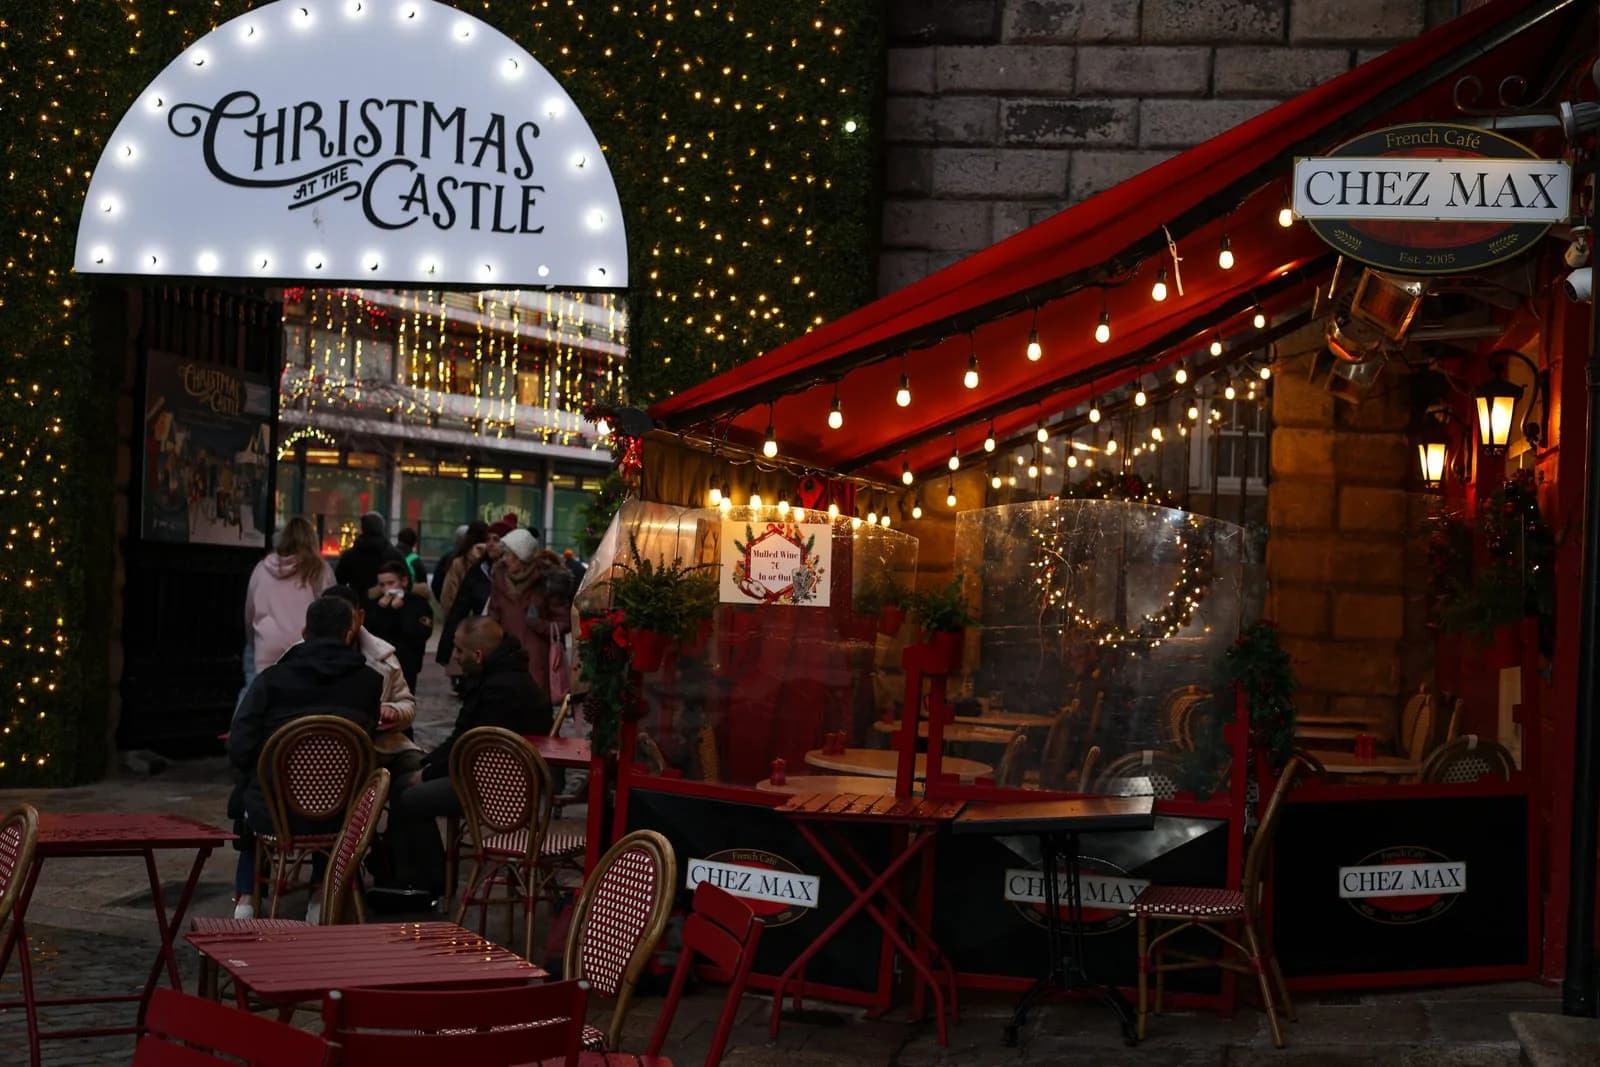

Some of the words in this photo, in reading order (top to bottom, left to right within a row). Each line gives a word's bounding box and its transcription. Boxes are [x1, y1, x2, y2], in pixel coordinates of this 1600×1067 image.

[168, 91, 540, 188] CHRISTMAS
[1385, 128, 1440, 148] French
[1444, 129, 1480, 149] Café
[293, 179, 317, 199] AT
[321, 166, 349, 189] THE
[362, 158, 546, 234] CASTLE
[1304, 170, 1431, 206] CHEZ
[1445, 171, 1559, 209] MAX
[1425, 253, 1456, 265] 2005
[753, 550, 778, 558] Mulled
[780, 550, 799, 559] Wine
[758, 572, 767, 580] In
[691, 865, 751, 892] CHEZ
[758, 875, 813, 901] MAX
[1343, 871, 1404, 892] CHEZ
[1411, 867, 1461, 890] MAX
